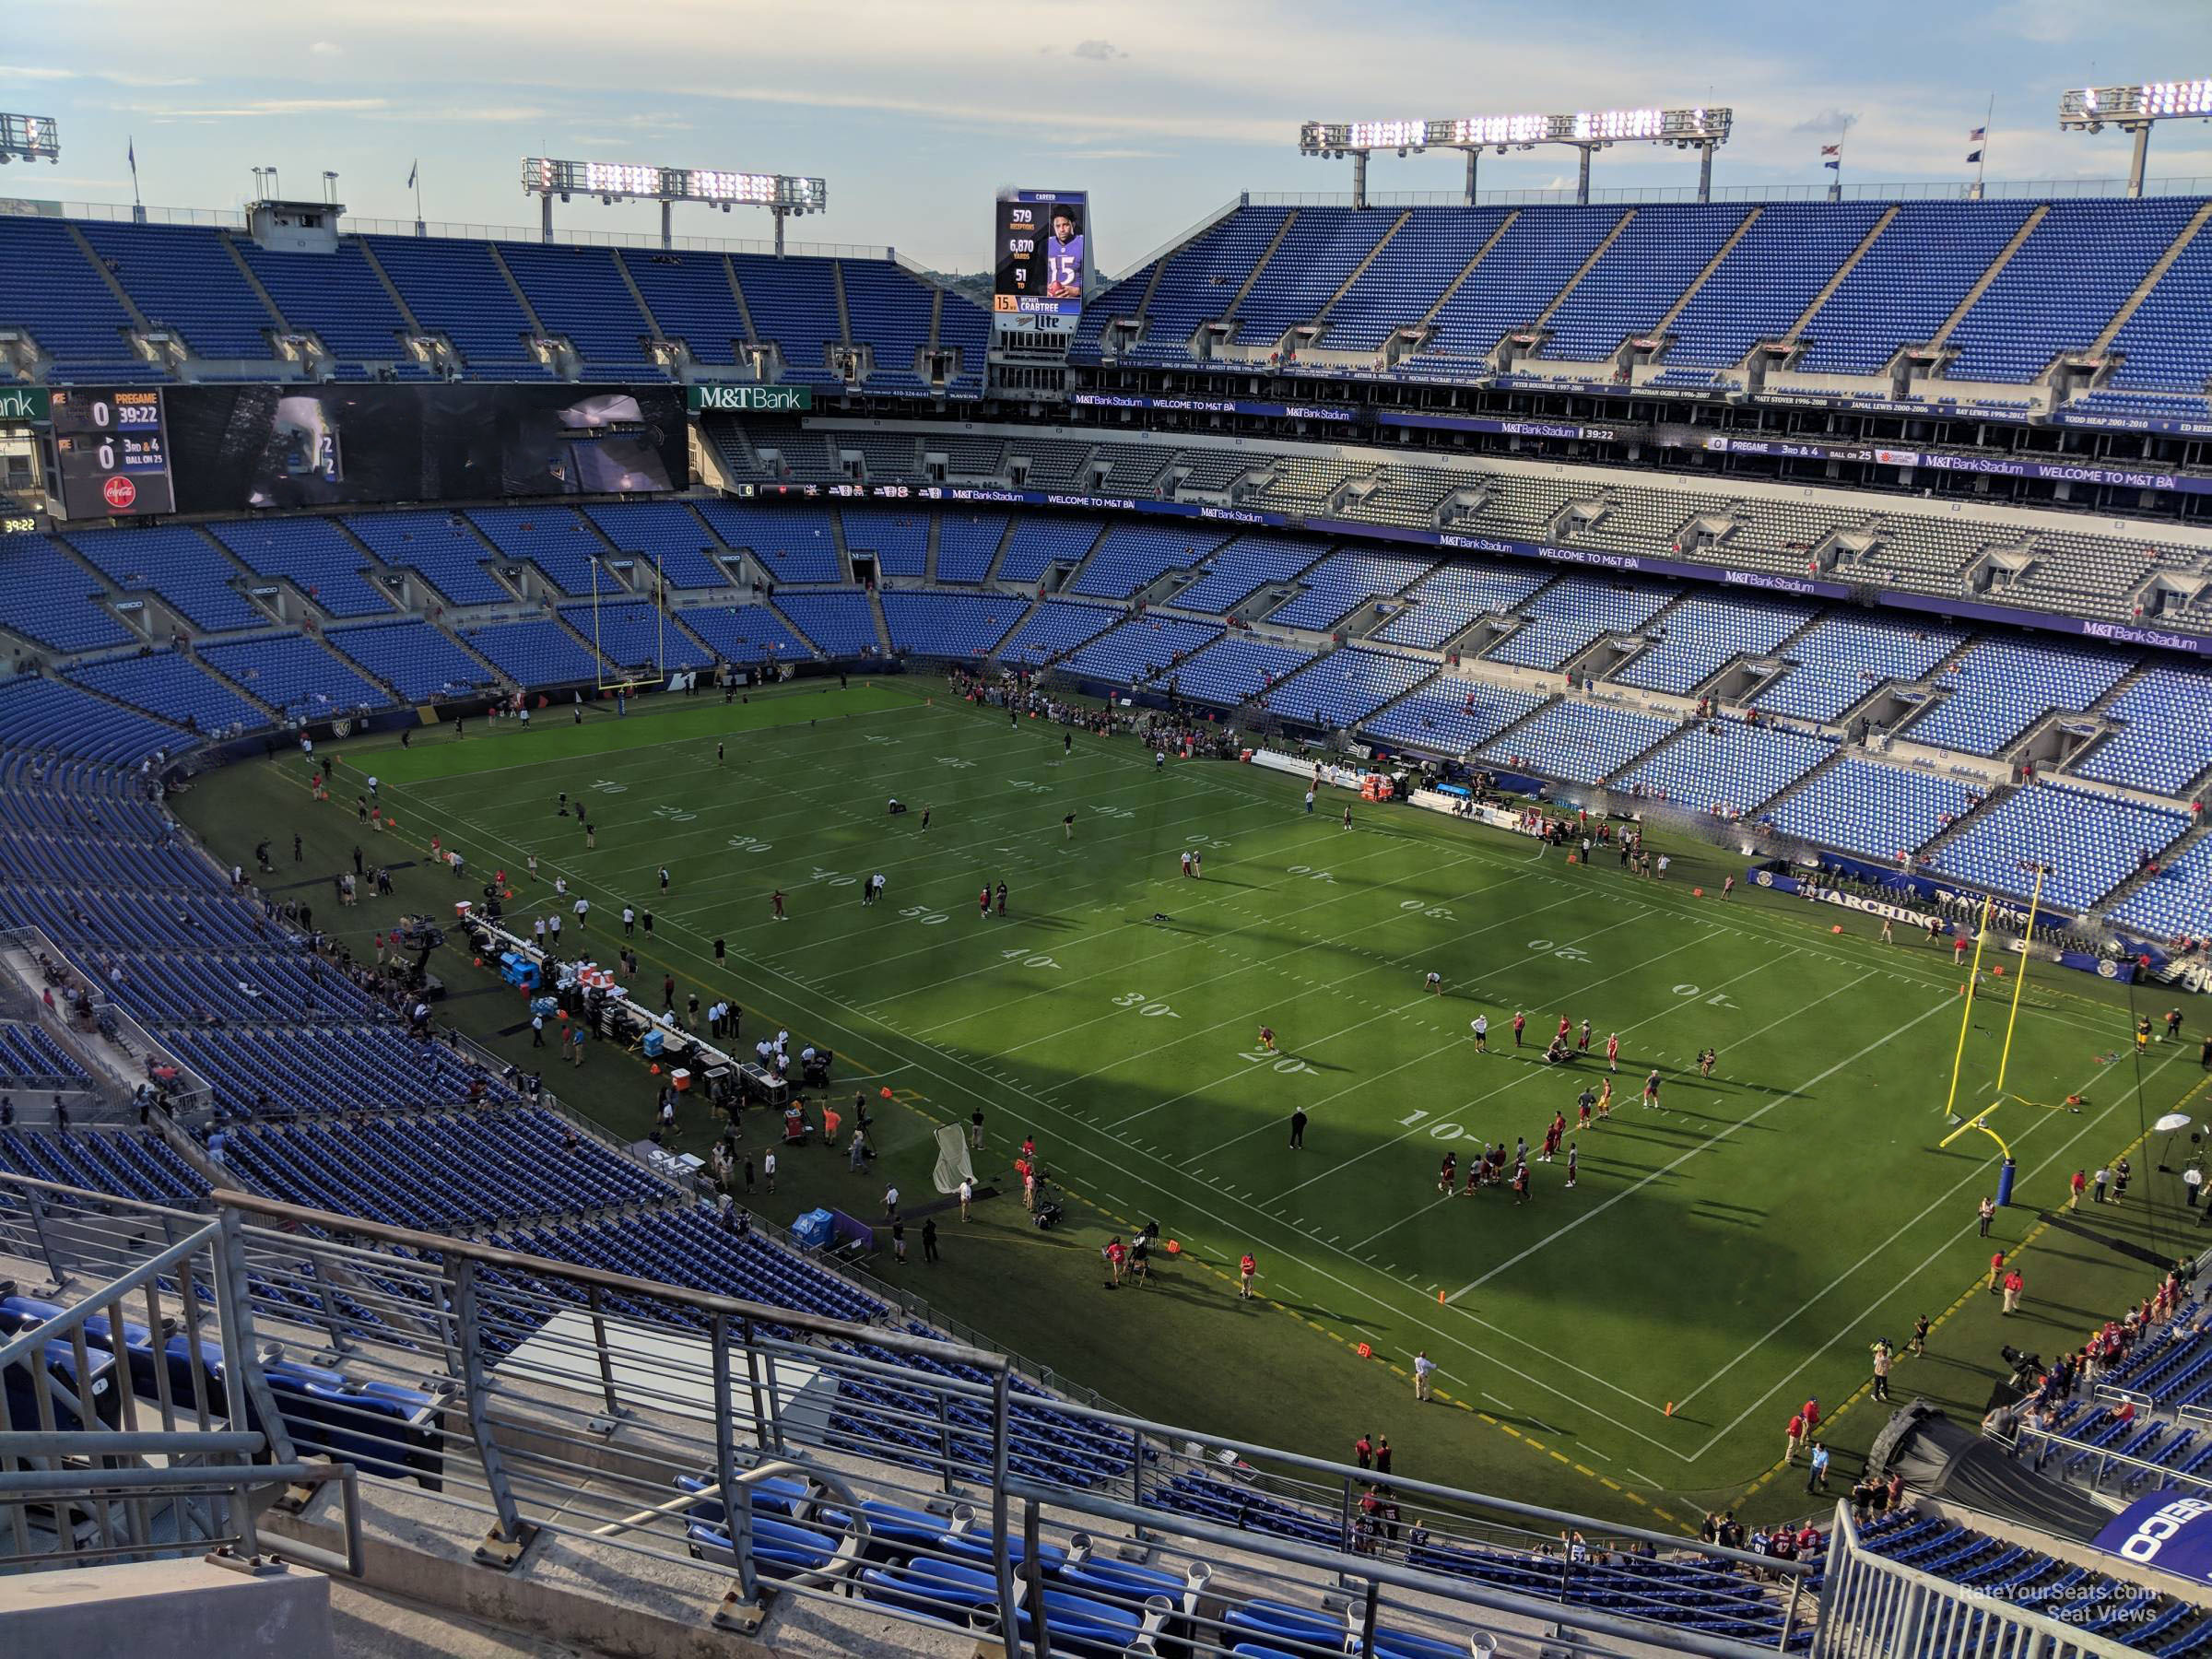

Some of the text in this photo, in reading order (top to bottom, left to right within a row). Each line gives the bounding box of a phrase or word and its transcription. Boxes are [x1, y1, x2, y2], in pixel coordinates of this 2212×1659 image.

[1013, 210, 1032, 222] 579
[1010, 240, 1034, 253] 6,870
[1016, 269, 1027, 282] 51
[997, 297, 1009, 310] 15
[1020, 302, 1059, 312] CRABTREE
[1034, 314, 1060, 330] Lite
[115, 393, 157, 404] PREGAME
[700, 387, 800, 409] M&T Bank
[1630, 388, 1665, 396] JONATHAN
[1076, 394, 1143, 407] M&T Bank Stadium
[1152, 399, 1191, 409] WELCOME
[1206, 402, 1222, 411] M&T
[1873, 403, 1893, 411] LEWIS
[1893, 404, 1928, 413] 2000-2006
[94, 402, 109, 426] 0
[120, 407, 157, 424] 39:22
[1287, 407, 1349, 420] M&T Bank Stadium
[2065, 415, 2148, 428] TODD HEAP 2001-2010
[2181, 423, 2191, 431] ED
[1502, 422, 1574, 437] M&T Bank Stadium
[1586, 429, 1613, 439] 39:22
[124, 438, 159, 453] 3RD & 4
[1714, 439, 1722, 450] 0
[1733, 441, 1768, 452] PREGAME
[1781, 444, 1798, 455] 3RD
[1799, 446, 1808, 455] &
[1810, 446, 1818, 456] 4
[1858, 450, 1871, 460] 25
[100, 445, 114, 469] 0
[144, 455, 153, 464] ON
[153, 455, 163, 464] 25
[1926, 455, 1953, 468] M&T
[1953, 457, 1980, 471] Bank
[1980, 459, 2024, 474] Stadium
[2039, 466, 2101, 482] WELCOME
[2105, 472, 2123, 483] TO
[2125, 474, 2154, 487] M&T
[952, 489, 1023, 502] M&T Bank Stadium
[1048, 494, 1089, 505] WELCOME
[1091, 498, 1102, 507] TO
[1104, 499, 1122, 508] M&T
[1202, 507, 1263, 523] M&T Bank Stadium
[6, 519, 35, 533] 39:22
[1440, 535, 1512, 553] M&T Bank Stadium
[1539, 547, 1585, 561] WELCOME
[1587, 553, 1600, 563] TO
[1602, 555, 1623, 566] M&T
[1725, 571, 1814, 594] M&T Bank Stadium
[2083, 621, 2197, 651] M&T Bank Stadium
[590, 781, 629, 793] 10
[653, 806, 697, 822] 20
[728, 836, 772, 853] 30
[1955, 888, 2017, 909] BALTIORE
[898, 906, 949, 924] 50
[1001, 948, 1053, 968] 40
[1112, 992, 1171, 1016] 30
[1238, 1045, 1307, 1073] 20
[1394, 1108, 1465, 1141] 10
[2121, 1498, 2212, 1563] GEICO
